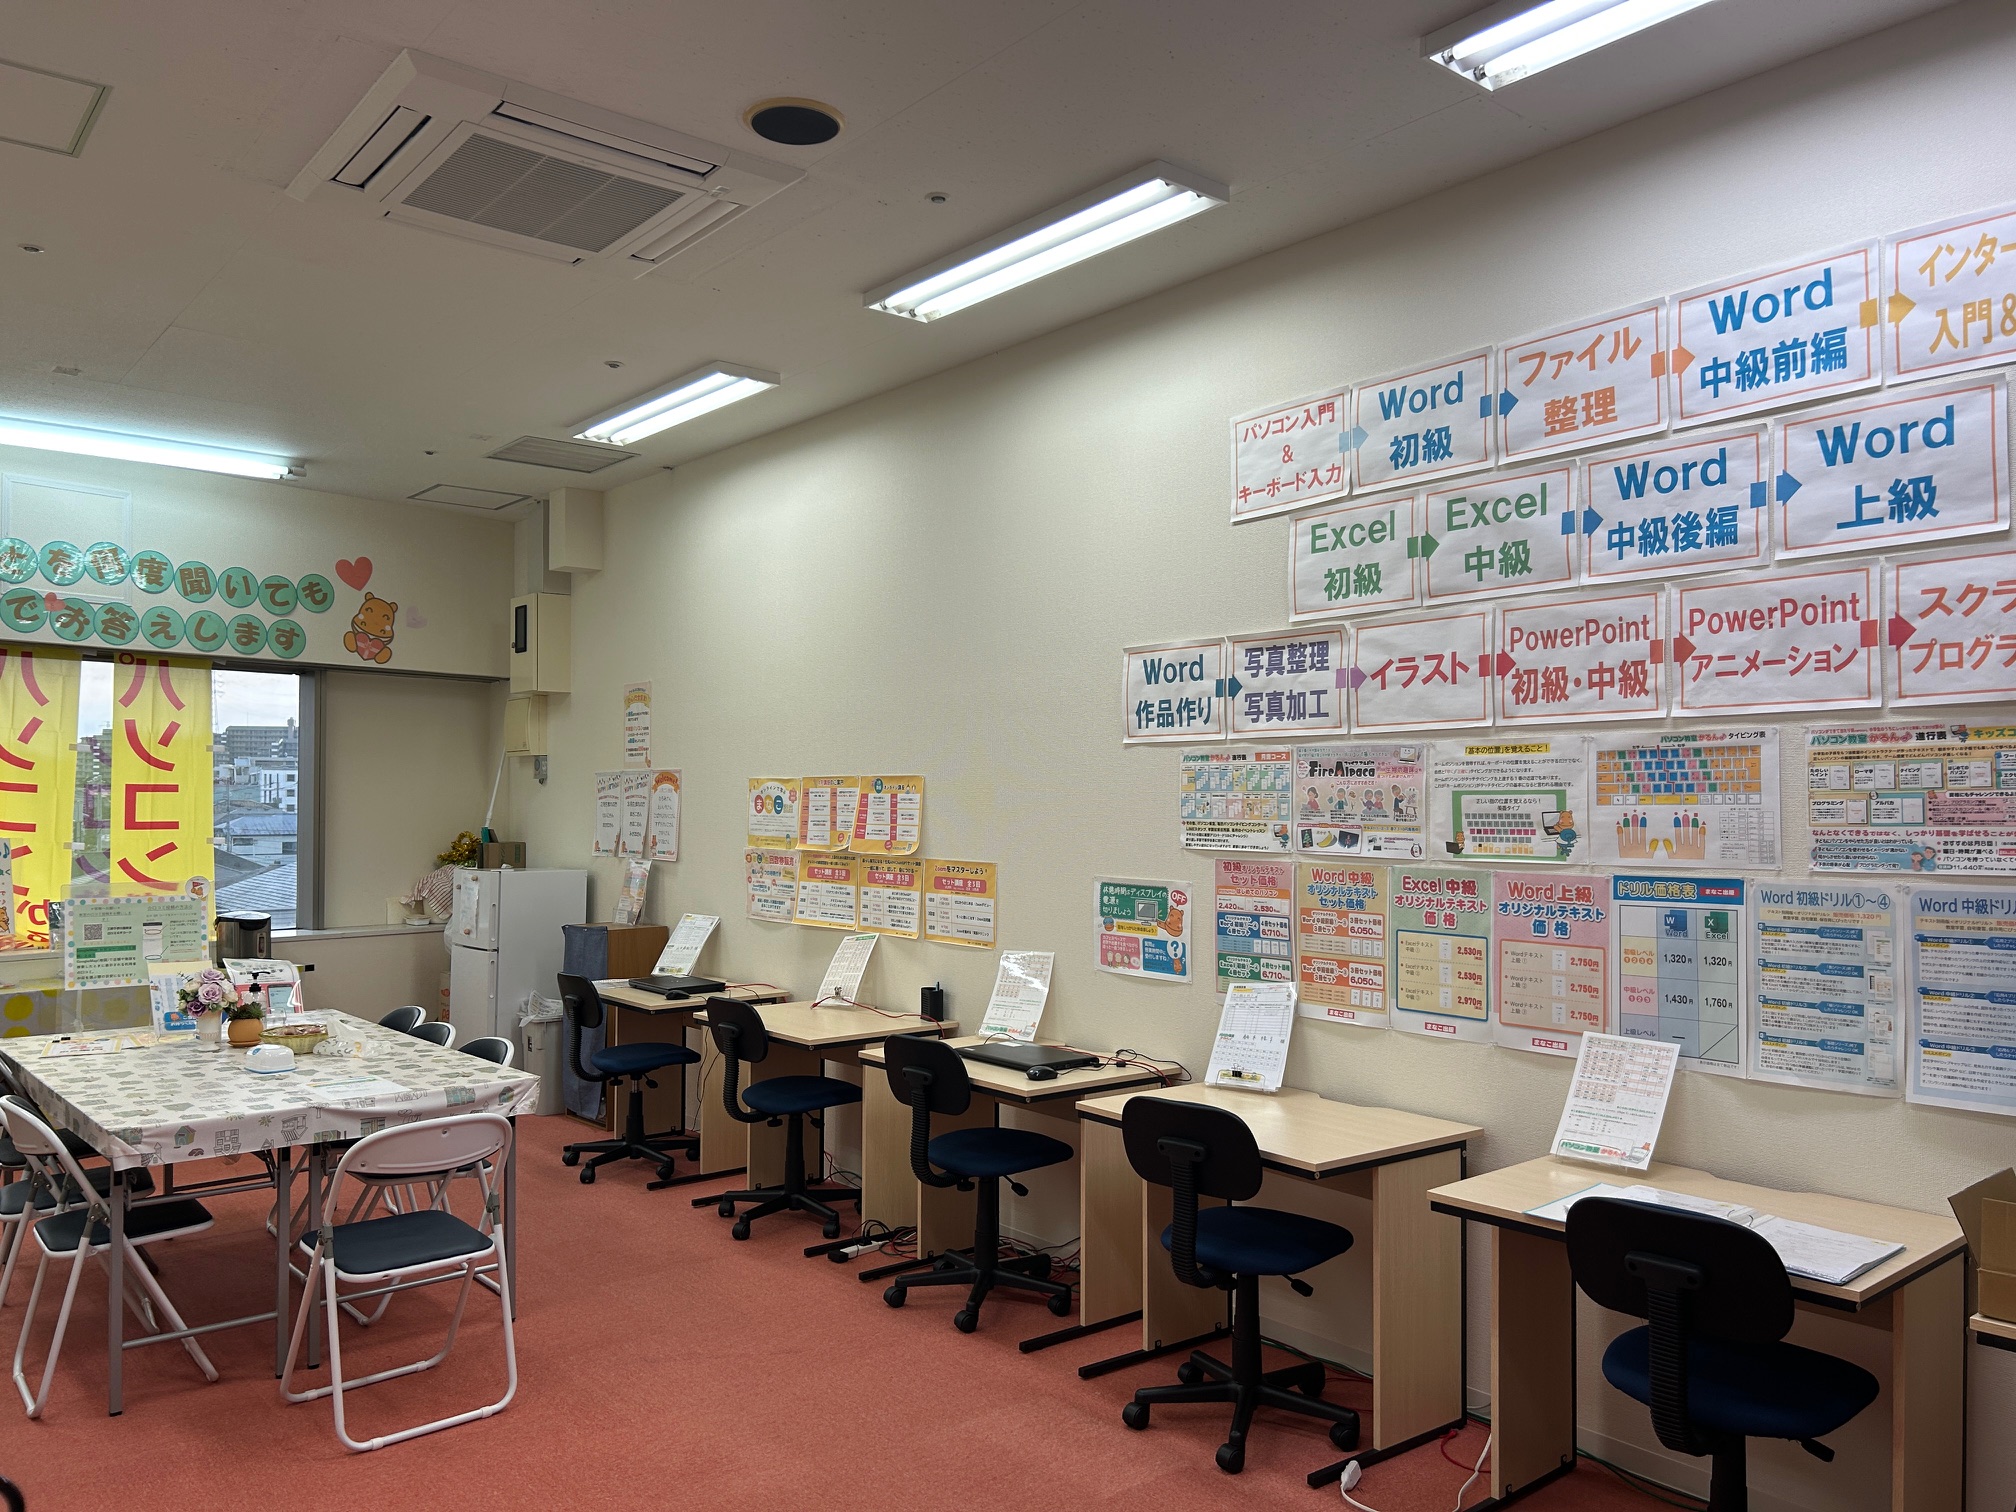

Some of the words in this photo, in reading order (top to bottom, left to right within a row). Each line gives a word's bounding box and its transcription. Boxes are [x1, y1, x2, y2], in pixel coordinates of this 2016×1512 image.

[1708, 267, 1833, 336] Word
[1518, 327, 1642, 388] ファイル
[1700, 326, 1847, 399] 中級前編
[1378, 371, 1464, 421] Word
[1544, 386, 1617, 438] 整理
[1243, 402, 1335, 443] パソコン入門
[1816, 404, 1955, 468] Word
[1282, 445, 1294, 464] &
[1389, 426, 1454, 470] 初級
[1239, 463, 1342, 503] キーボード入力
[1613, 447, 1727, 501] Word
[1447, 482, 1547, 532] Excel
[1836, 474, 1940, 530] 上級
[1311, 510, 1395, 555] Excel
[1606, 504, 1740, 562] 中級後編
[1465, 539, 1533, 582] 中級
[1324, 562, 1383, 601] 初級
[1688, 592, 1860, 637] PowerPoint
[1510, 614, 1650, 653] PowerPoint
[1142, 653, 1205, 686] Word
[1244, 640, 1330, 679] 写真整理
[1370, 651, 1471, 691] イラスト
[1690, 643, 1860, 683] アニメーション
[1511, 659, 1650, 706] 初級・中級
[1135, 696, 1212, 730] 作品作り
[1244, 689, 1330, 724] 写真加工
[1728, 731, 1766, 739] タイピング表
[1915, 728, 1947, 741] 進行表
[1309, 760, 1376, 777] FireAlpaca
[1231, 874, 1277, 886] セット価格
[1307, 884, 1378, 899] オリジナルテキスト
[1312, 867, 1345, 883] Word
[1348, 871, 1373, 885] 中級
[1402, 875, 1442, 893] Excel
[1445, 878, 1477, 897] 中級
[1508, 881, 1554, 901] Word
[1556, 885, 1593, 904] 上級
[1618, 881, 1697, 899] ドリル価格表
[1171, 892, 1187, 903] OFF
[1318, 896, 1366, 910] セット価格
[1394, 894, 1488, 912] オリジナルテキスト
[1498, 902, 1606, 922] オリジナルテキスト
[1761, 890, 1794, 904] Word
[1919, 897, 1958, 913] Word
[1665, 929, 1689, 938] Word
[1705, 931, 1729, 940] Excel
[1457, 946, 1483, 956] 2,530円
[1570, 957, 1599, 968] 2,750円
[1457, 971, 1483, 981] 2,530円
[1570, 983, 1599, 994] 2,750円
[1570, 1010, 1599, 1022] 2,750円
